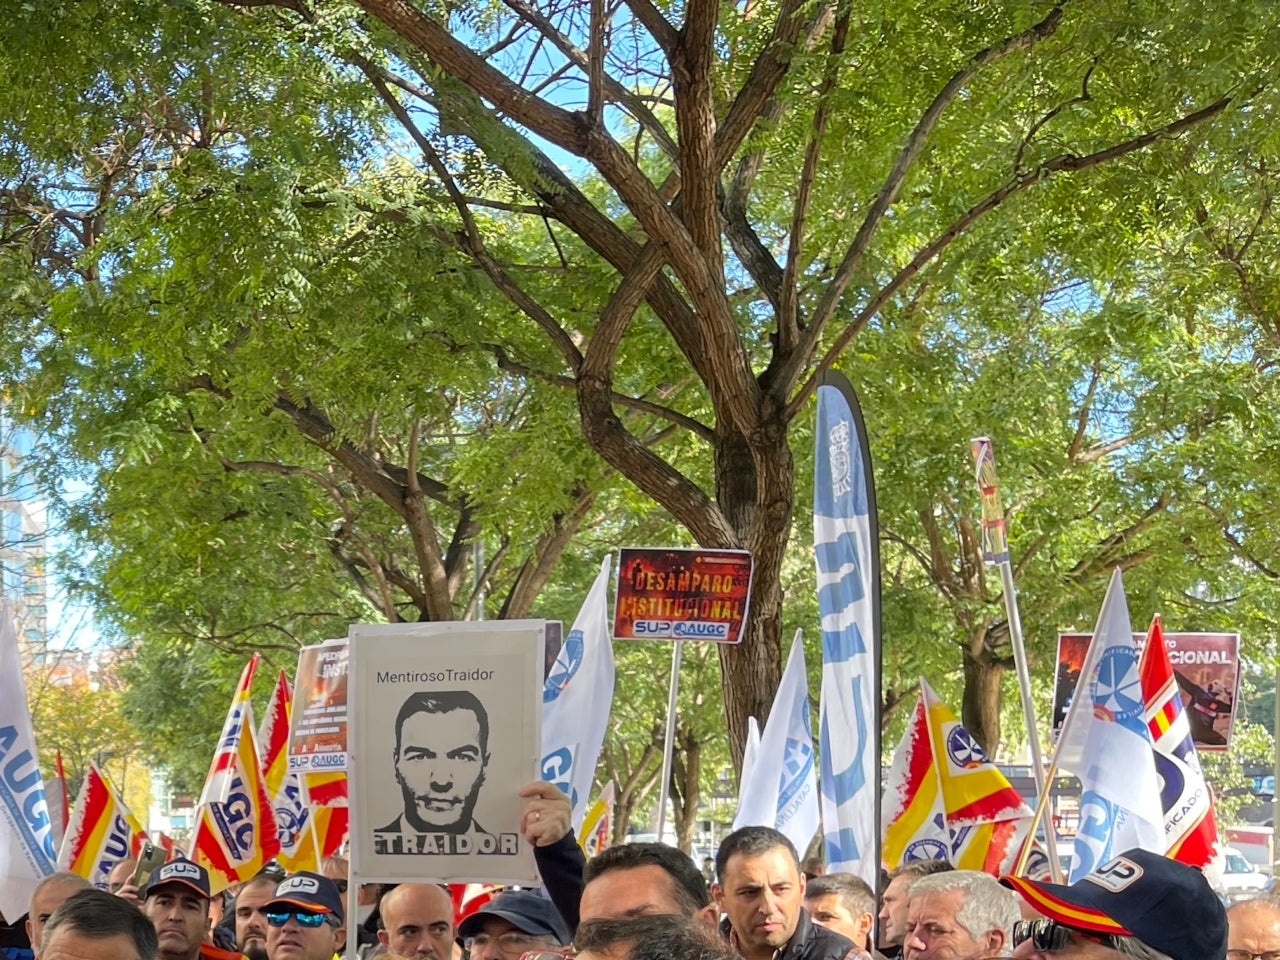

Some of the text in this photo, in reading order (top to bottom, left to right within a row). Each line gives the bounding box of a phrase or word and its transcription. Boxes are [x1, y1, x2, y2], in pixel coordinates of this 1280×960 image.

[635, 571, 733, 593] DESAMPARO
[620, 597, 742, 620] INSTITUCIONAL
[635, 621, 671, 633] SUP
[687, 623, 726, 634] AUGC
[1167, 651, 1232, 665] CIONAL
[289, 757, 310, 768] SUP
[320, 754, 346, 765] AUGC
[1164, 787, 1203, 836] FICADO
[162, 864, 199, 878] SUP
[281, 879, 317, 892] SUP
